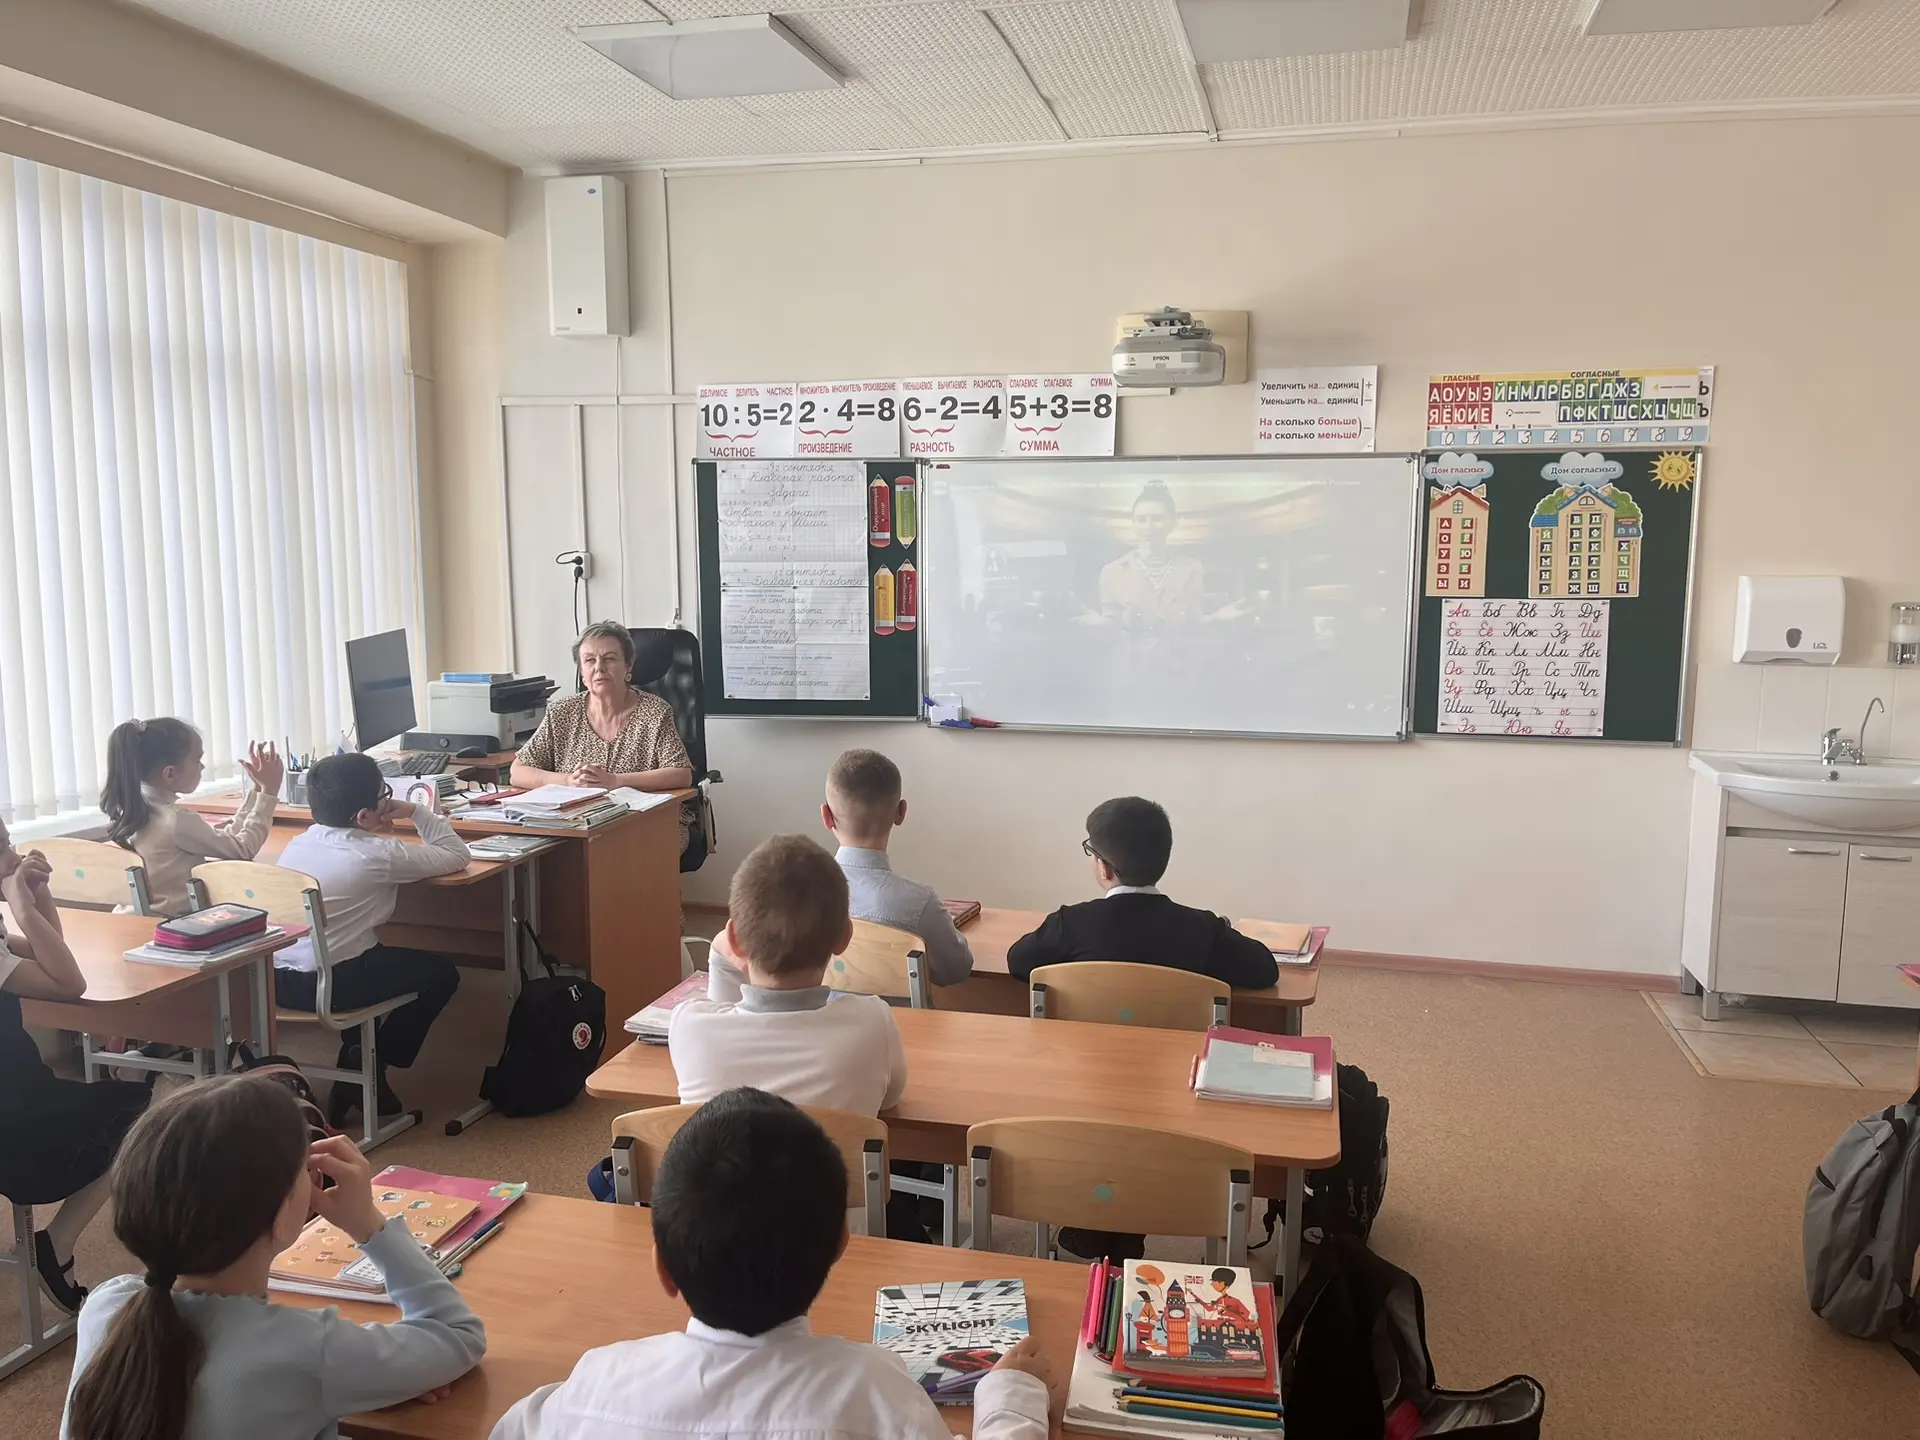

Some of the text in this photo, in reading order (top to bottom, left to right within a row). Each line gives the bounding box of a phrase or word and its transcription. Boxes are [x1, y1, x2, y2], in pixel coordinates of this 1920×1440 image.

[1443, 374, 1480, 382] ГЛАСНЫЕ
[1570, 370, 1620, 378] СОГЛАСНЫЕ
[800, 382, 896, 395] МНОЖИТЕЛЬ МНОЖИТЕЛЬ ПРОИЗВЕДЕНИЕ
[938, 380, 967, 390] ВЫЧИТАЕМОЕ
[974, 380, 1002, 389] РАЗНОСТЬ
[1009, 377, 1112, 388] СЛАГАЕМОЕ СЛАГАЕМОЕ СУММА
[1261, 382, 1306, 390] Увеличить
[1328, 382, 1360, 390] единиц
[700, 386, 793, 398] ДЕЛИМОЕ ДЕЛИТЕЛЬ ЧАСТНОЕ
[1260, 397, 1306, 406] Уменьшить
[1327, 397, 1359, 406] единиц
[1260, 417, 1357, 426] На сколько больше
[1260, 432, 1272, 440] На
[1274, 432, 1315, 440] сколько
[1445, 427, 1692, 445] 0 1 2 3 4 5 6 7 8 9
[710, 446, 756, 458] ЧАСТНОЕ
[798, 442, 852, 454] ПРОИЗВЕДЕНИЕ
[910, 441, 955, 453] РАЗНОСТЬ
[1019, 440, 1060, 452] СУММА
[1550, 466, 1617, 475] Дом согласных
[808, 472, 855, 484] работа
[1448, 602, 1604, 623] Аа Бб Вв Гг Дд
[1448, 621, 1602, 644] Ее Ёё Жж Зз Ии
[1446, 639, 1602, 658] Йй Кк Лл Мм Нн
[1444, 660, 1600, 682] Оо Пп Рр Сс Тт
[1444, 678, 1598, 700] Уу Фф Хх Цц Чч
[1444, 698, 1474, 714] Шш
[1489, 700, 1521, 718] Щщ
[1457, 718, 1572, 736] Ээ Юю Яя
[905, 1318, 996, 1334] SKYLIGHT
